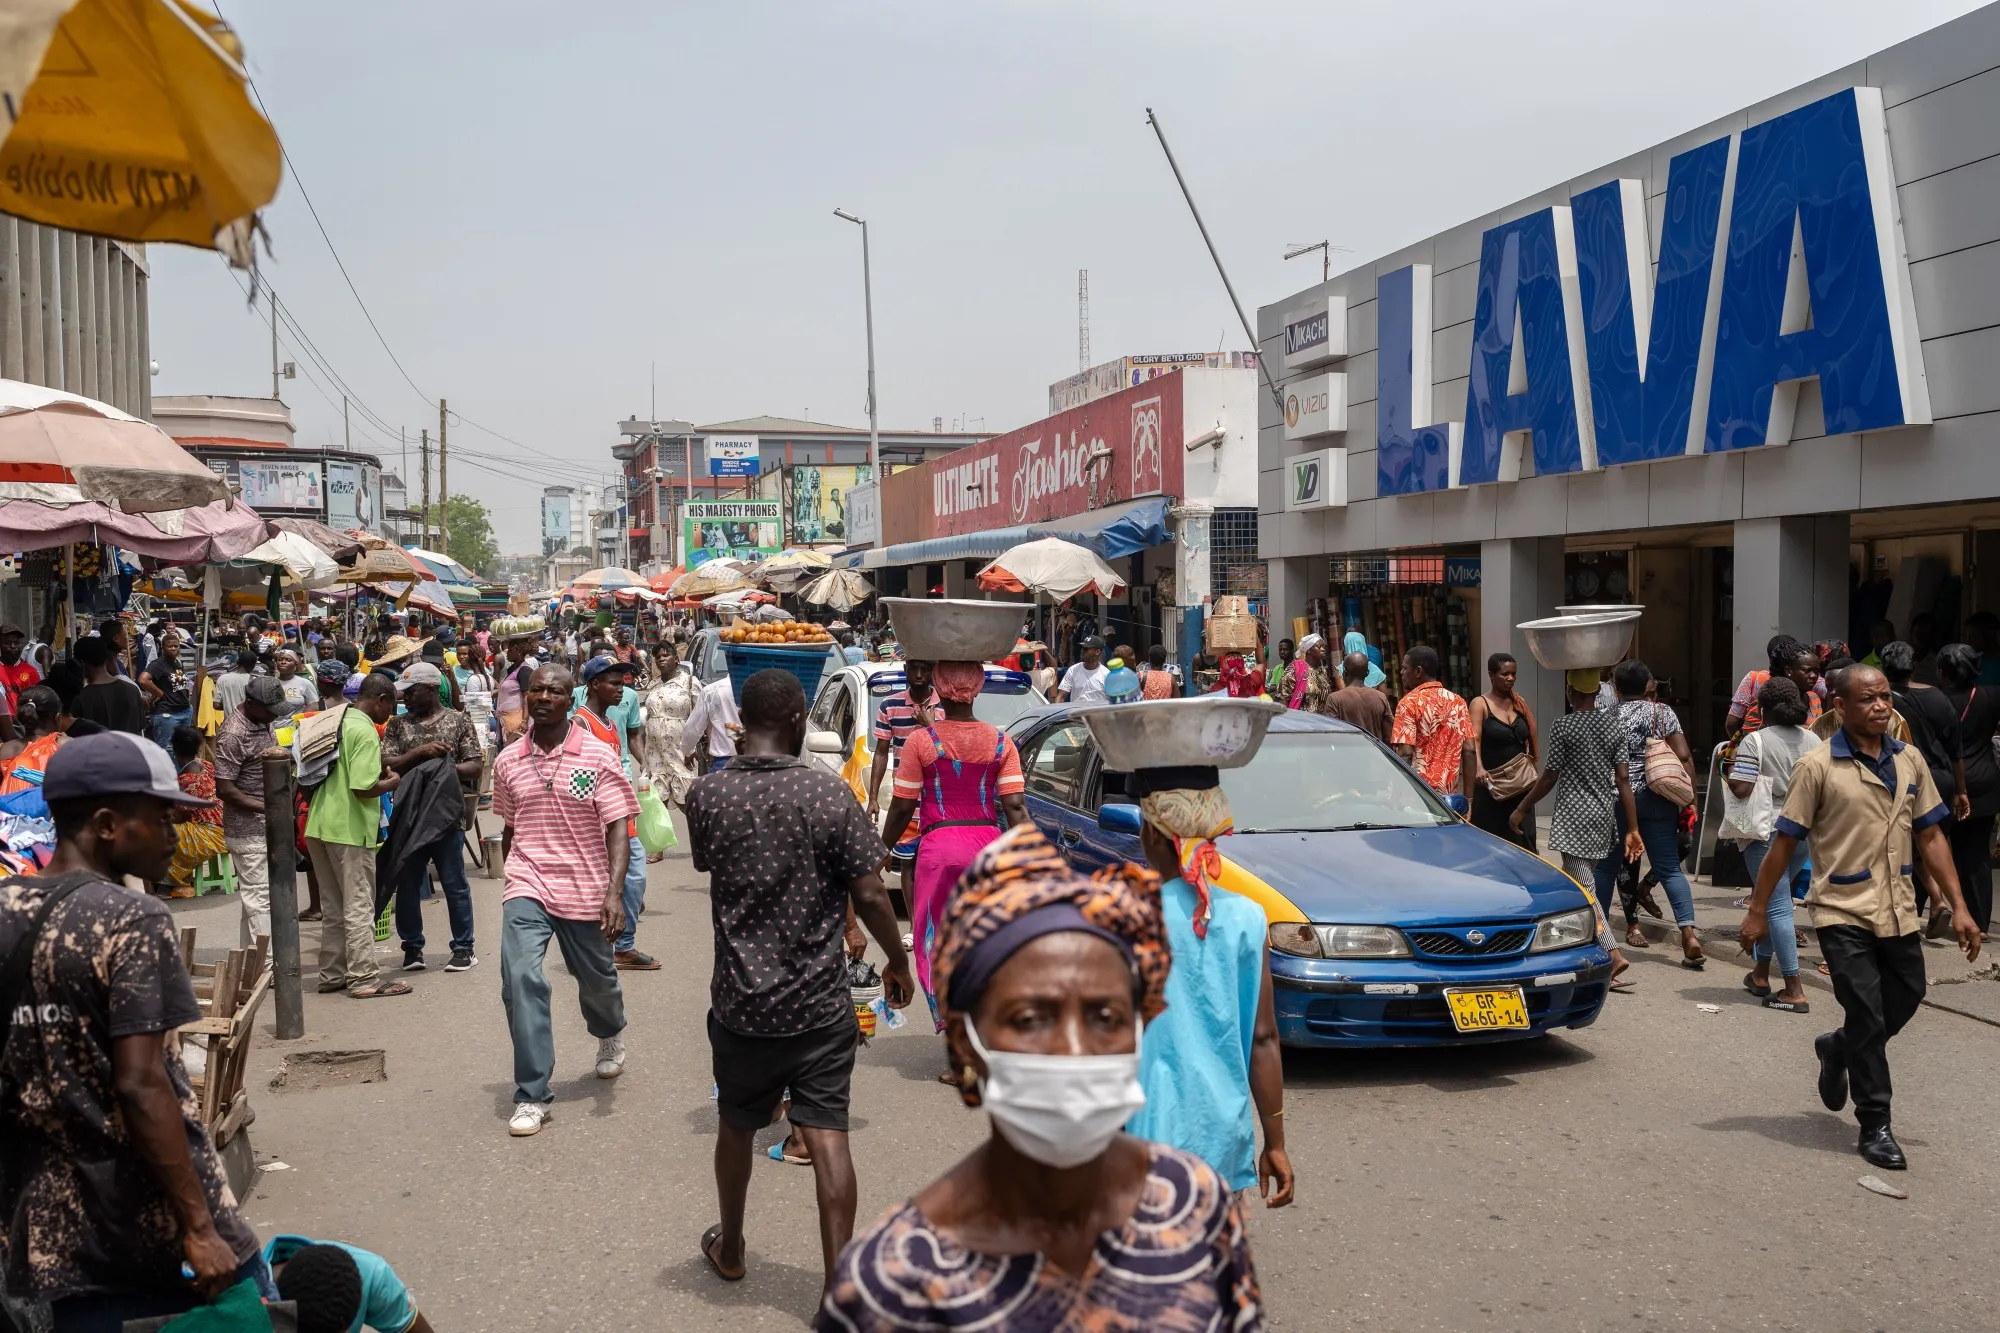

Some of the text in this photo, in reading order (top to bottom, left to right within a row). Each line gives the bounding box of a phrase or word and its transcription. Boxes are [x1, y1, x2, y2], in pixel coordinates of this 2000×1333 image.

[1377, 86, 1932, 498] LAVA
[1286, 317, 1327, 355] MIKACHI
[1133, 353, 1203, 364] GLORY BE TO GOD
[1301, 392, 1328, 416] VIZIO
[933, 453, 999, 517] ULTIMATE
[1011, 431, 1108, 523] Fashion
[1296, 462, 1319, 500] YD
[689, 504, 777, 517] HIS MAJESTY PHONES
[1448, 565, 1481, 583] MIKA
[1475, 993, 1497, 1009] GR
[1460, 1009, 1523, 1027] 6460-14
